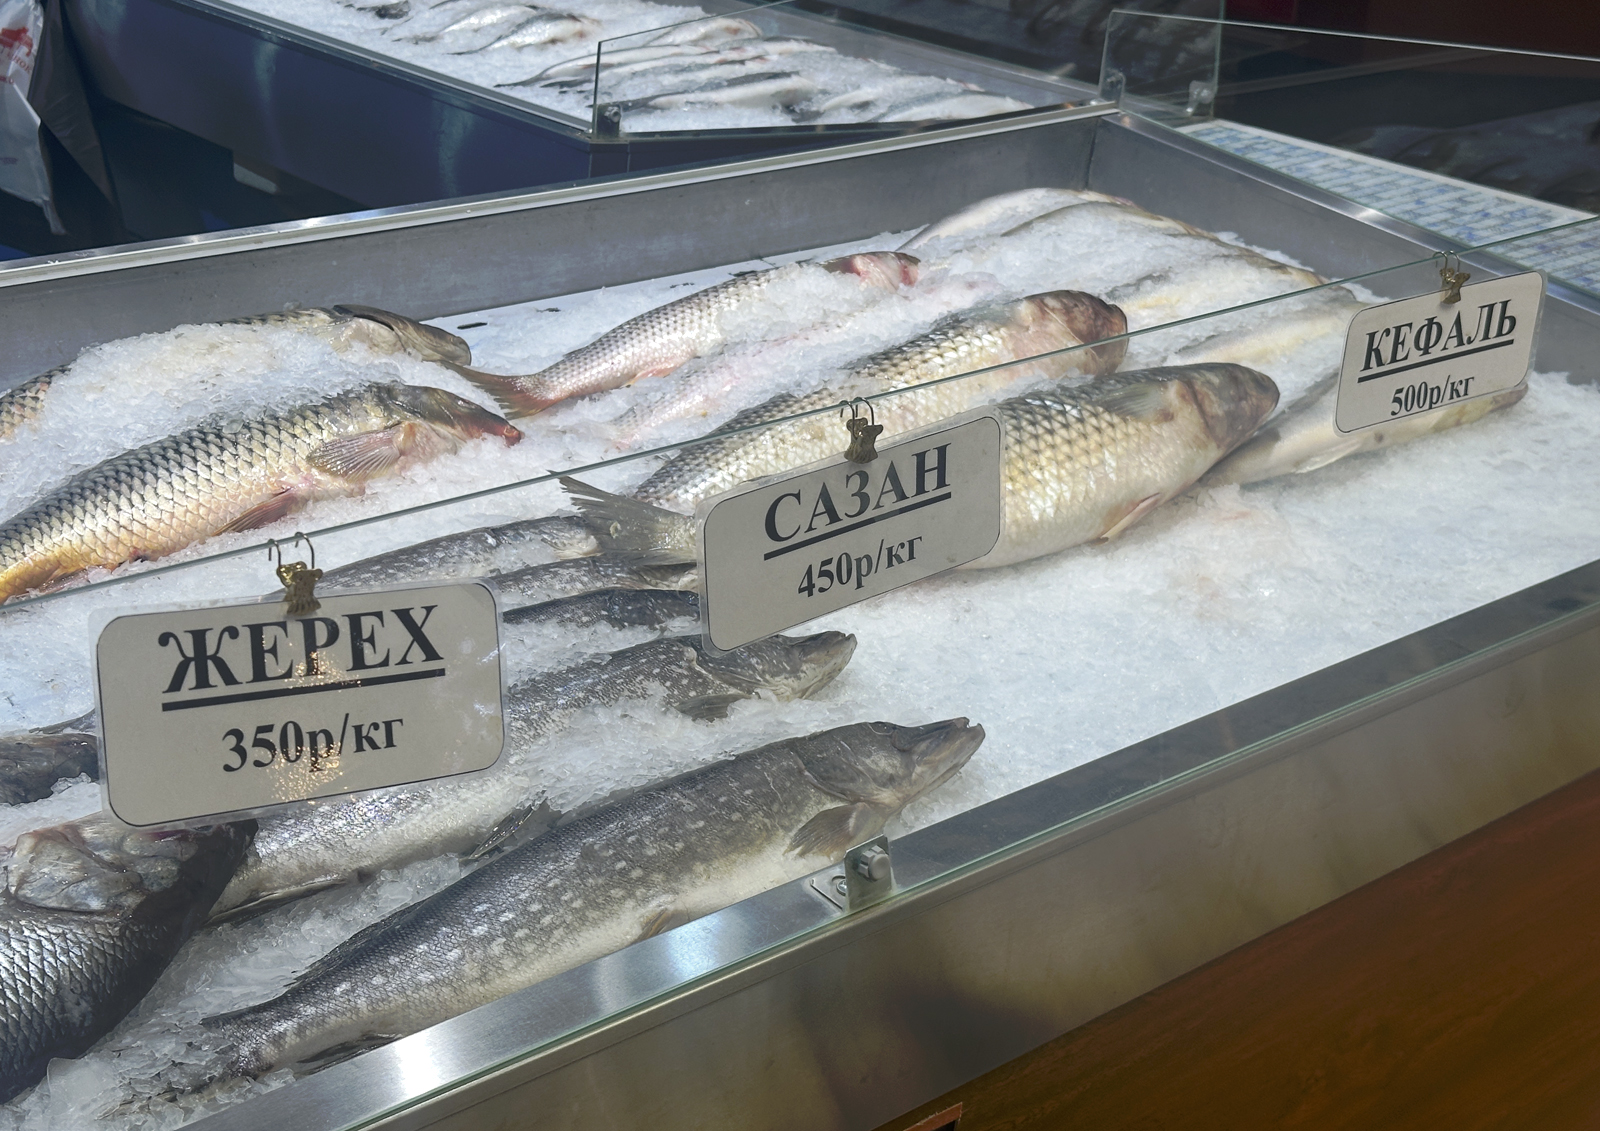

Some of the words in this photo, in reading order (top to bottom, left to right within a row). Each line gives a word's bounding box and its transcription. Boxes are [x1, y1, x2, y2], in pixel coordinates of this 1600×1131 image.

[1360, 299, 1517, 372] КЕФАЛЬ
[1390, 374, 1475, 416] 500р/кг
[764, 442, 952, 543] САЗАН
[797, 536, 923, 598] 450р/кг
[157, 604, 446, 694] ЖЕРЕХ
[221, 712, 405, 773] 350р/кг
